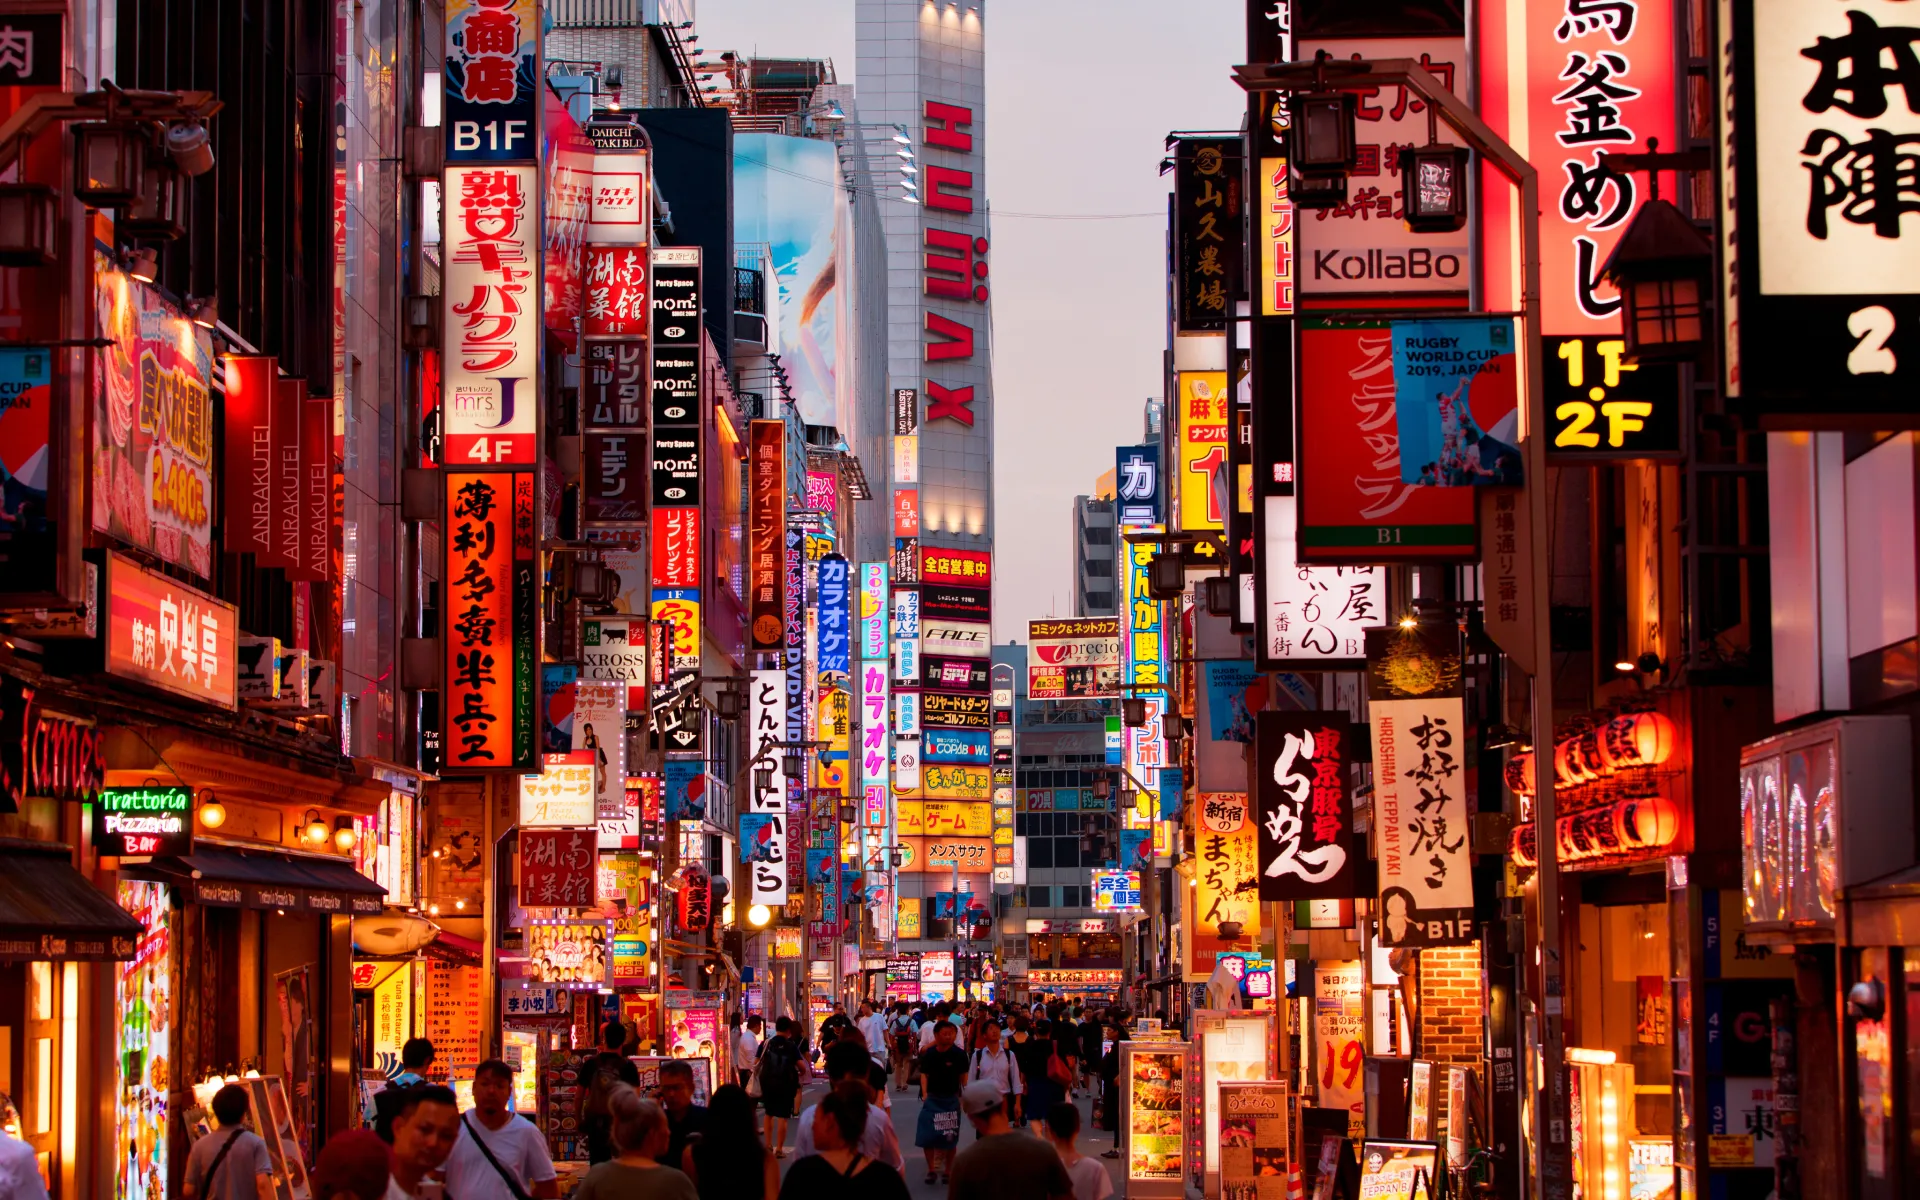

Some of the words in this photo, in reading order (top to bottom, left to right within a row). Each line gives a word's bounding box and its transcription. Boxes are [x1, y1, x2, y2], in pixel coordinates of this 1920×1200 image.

[454, 120, 527, 150] B1F
[592, 128, 631, 137] DAIICHI
[622, 139, 644, 148] BLD
[595, 196, 636, 206] ラウンジ
[600, 187, 633, 196] カブキ
[1194, 180, 1226, 310] 山久農場
[452, 170, 532, 374] 熟女キャバクラ
[586, 251, 644, 287] 湖南
[1314, 248, 1460, 280] KollaBo
[656, 280, 673, 288] Party
[673, 280, 694, 288] Space
[586, 289, 645, 321] 菜館
[604, 322, 626, 333] 4F
[669, 329, 681, 337] 5F
[1405, 337, 1460, 349] RUGBY
[1846, 304, 1897, 375] 2
[656, 360, 673, 368] Party
[673, 360, 694, 368] Space
[1406, 350, 1463, 362] WORLD
[1467, 350, 1499, 362] CUP
[1557, 339, 1639, 388] 1F
[1406, 364, 1446, 377] 2019,
[1448, 363, 1501, 376] JAPAN
[618, 345, 641, 424] レンタル
[455, 394, 495, 411] mrs.
[474, 377, 528, 429] J
[669, 409, 681, 417] 4F
[898, 389, 906, 418] CUSTOMA
[1191, 428, 1228, 440] ナンバ
[1554, 401, 1653, 448] 2F
[468, 437, 513, 463] 4F
[656, 440, 673, 448] Party
[673, 440, 694, 448] Space
[601, 437, 627, 497] エデン
[252, 425, 270, 546] ANRAKUTEI
[669, 489, 681, 497] 3F
[282, 444, 300, 561] ANRAKUTEI
[901, 499, 917, 528] 白木屋
[310, 462, 328, 575] ANRAKUTEI
[515, 479, 534, 550] 炭火串焼
[759, 444, 774, 602] 個室ダイニング居酒屋
[685, 510, 695, 554] レンタルルーム
[1376, 527, 1402, 544] B1
[667, 510, 682, 586] リフレッシュ
[1494, 494, 1519, 622] 劇場通り一番街
[685, 557, 695, 583] ホステル
[924, 556, 987, 578] 全店営業中
[667, 590, 684, 599] 1F
[786, 549, 801, 646] ホテルがライバル
[822, 560, 845, 653] カラオケ
[908, 592, 918, 632] カラオケ
[897, 604, 907, 632] の鉄人
[1273, 600, 1293, 656] 一番街
[587, 625, 598, 636] 肉
[926, 628, 988, 643] FACE
[131, 617, 156, 670] 焼肉
[159, 593, 218, 691] 安楽亭
[586, 653, 643, 665] XROSS
[675, 656, 698, 667] 天神
[821, 654, 846, 669] 747
[901, 641, 913, 677] SEGA
[592, 667, 638, 680] CASA
[1031, 667, 1064, 677] 新宿最大
[1212, 667, 1239, 675] RUGBY
[924, 695, 989, 713] ビリヤード&ダーツ
[1031, 689, 1065, 697] ハイジアB1
[833, 691, 847, 736] 麻雀
[864, 666, 886, 777] カラオケ
[901, 695, 913, 732] SEGA
[944, 713, 966, 724] ゴルフ
[678, 732, 691, 740] B1
[549, 754, 566, 763] 2F
[1379, 716, 1396, 786] HIROSHIMA
[926, 767, 988, 789] まんが喫茶
[1310, 726, 1343, 844] 東京豚骨
[101, 789, 187, 812] Trattoria
[524, 783, 591, 796] マッサージ
[1404, 714, 1465, 890] お好み焼き
[926, 812, 967, 830] ゲーム
[1383, 793, 1401, 844] TEPPAN
[122, 833, 161, 853] Bar
[524, 832, 591, 872] 湖南
[929, 844, 986, 858] メンズサウナ
[1386, 844, 1402, 876] YAKI
[540, 872, 590, 904] 菜館
[1100, 877, 1129, 891] 完全
[1203, 835, 1233, 924] まっちゃん
[1113, 890, 1140, 904] 個室
[1427, 920, 1472, 939] B1F
[353, 963, 379, 986] 店
[923, 966, 953, 977] ゲーム
[1246, 959, 1272, 969] フリー
[395, 979, 404, 1000] Tuna
[508, 997, 520, 1012] 李
[521, 997, 545, 1011] 小牧
[395, 1001, 404, 1050] Restaurant
[1362, 1185, 1399, 1200] TEPPAN
